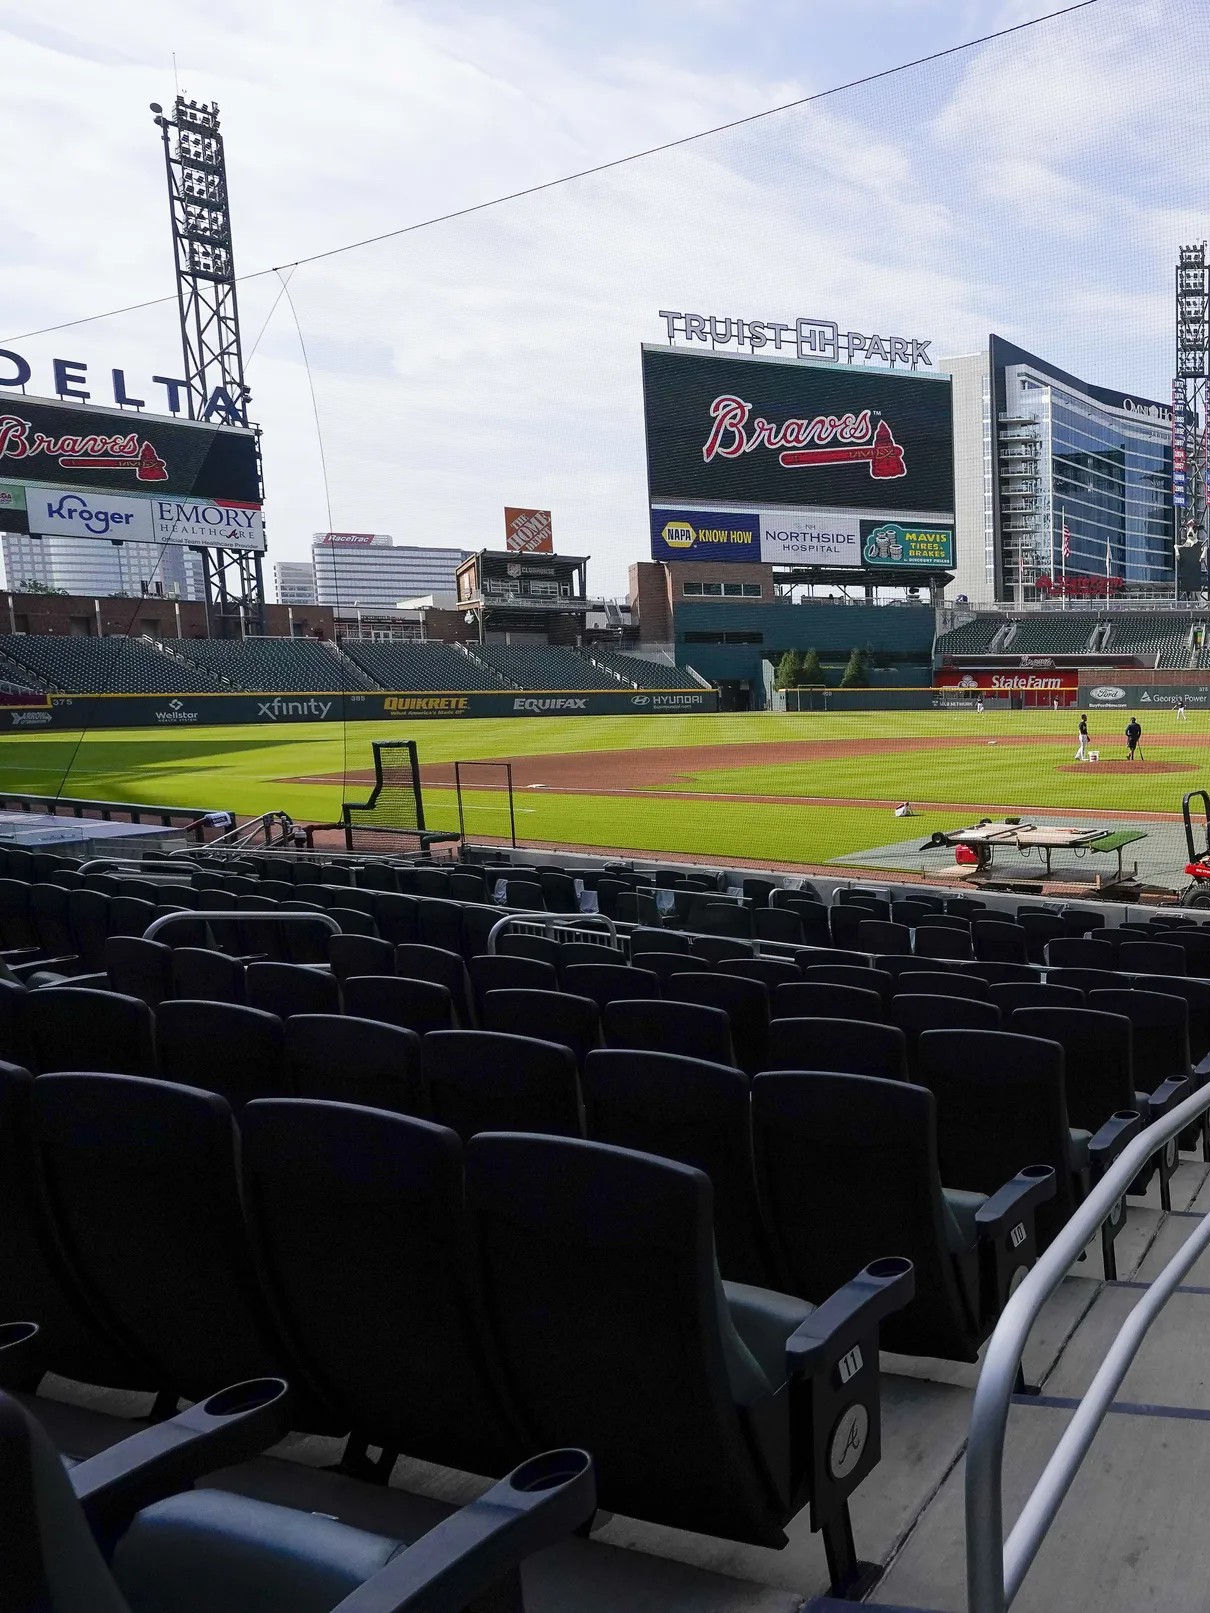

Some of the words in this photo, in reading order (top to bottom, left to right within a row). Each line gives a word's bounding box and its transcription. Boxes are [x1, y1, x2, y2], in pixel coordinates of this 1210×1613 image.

[659, 310, 788, 349] TRUIST
[847, 331, 932, 365] PARK
[0, 348, 249, 428] DELTA
[0, 415, 138, 459] Braves
[703, 395, 871, 463] Braves
[47, 495, 134, 534] Kroger
[158, 502, 257, 528] EMORY
[510, 514, 530, 530] THE
[160, 524, 254, 539] HEALTHCARE
[328, 534, 370, 543] RaceTrac
[507, 512, 551, 550] HOME
[526, 527, 552, 551] DEPOT
[667, 528, 692, 542] NAPA
[699, 530, 729, 544] KNOW
[730, 531, 752, 544] HOW
[765, 530, 856, 544] NORTHSIDE
[905, 532, 947, 542] MAVIS
[202, 541, 234, 549] Healthcare
[783, 544, 840, 553] HOSPITAL
[910, 542, 939, 550] TIRES
[1097, 688, 1117, 698] Ford
[1153, 694, 1182, 703] Georgia
[258, 697, 332, 720] xfinity
[384, 697, 467, 710] QUIKRETE
[513, 699, 587, 712] EQUIFAX
[844, 1351, 858, 1376] 11
